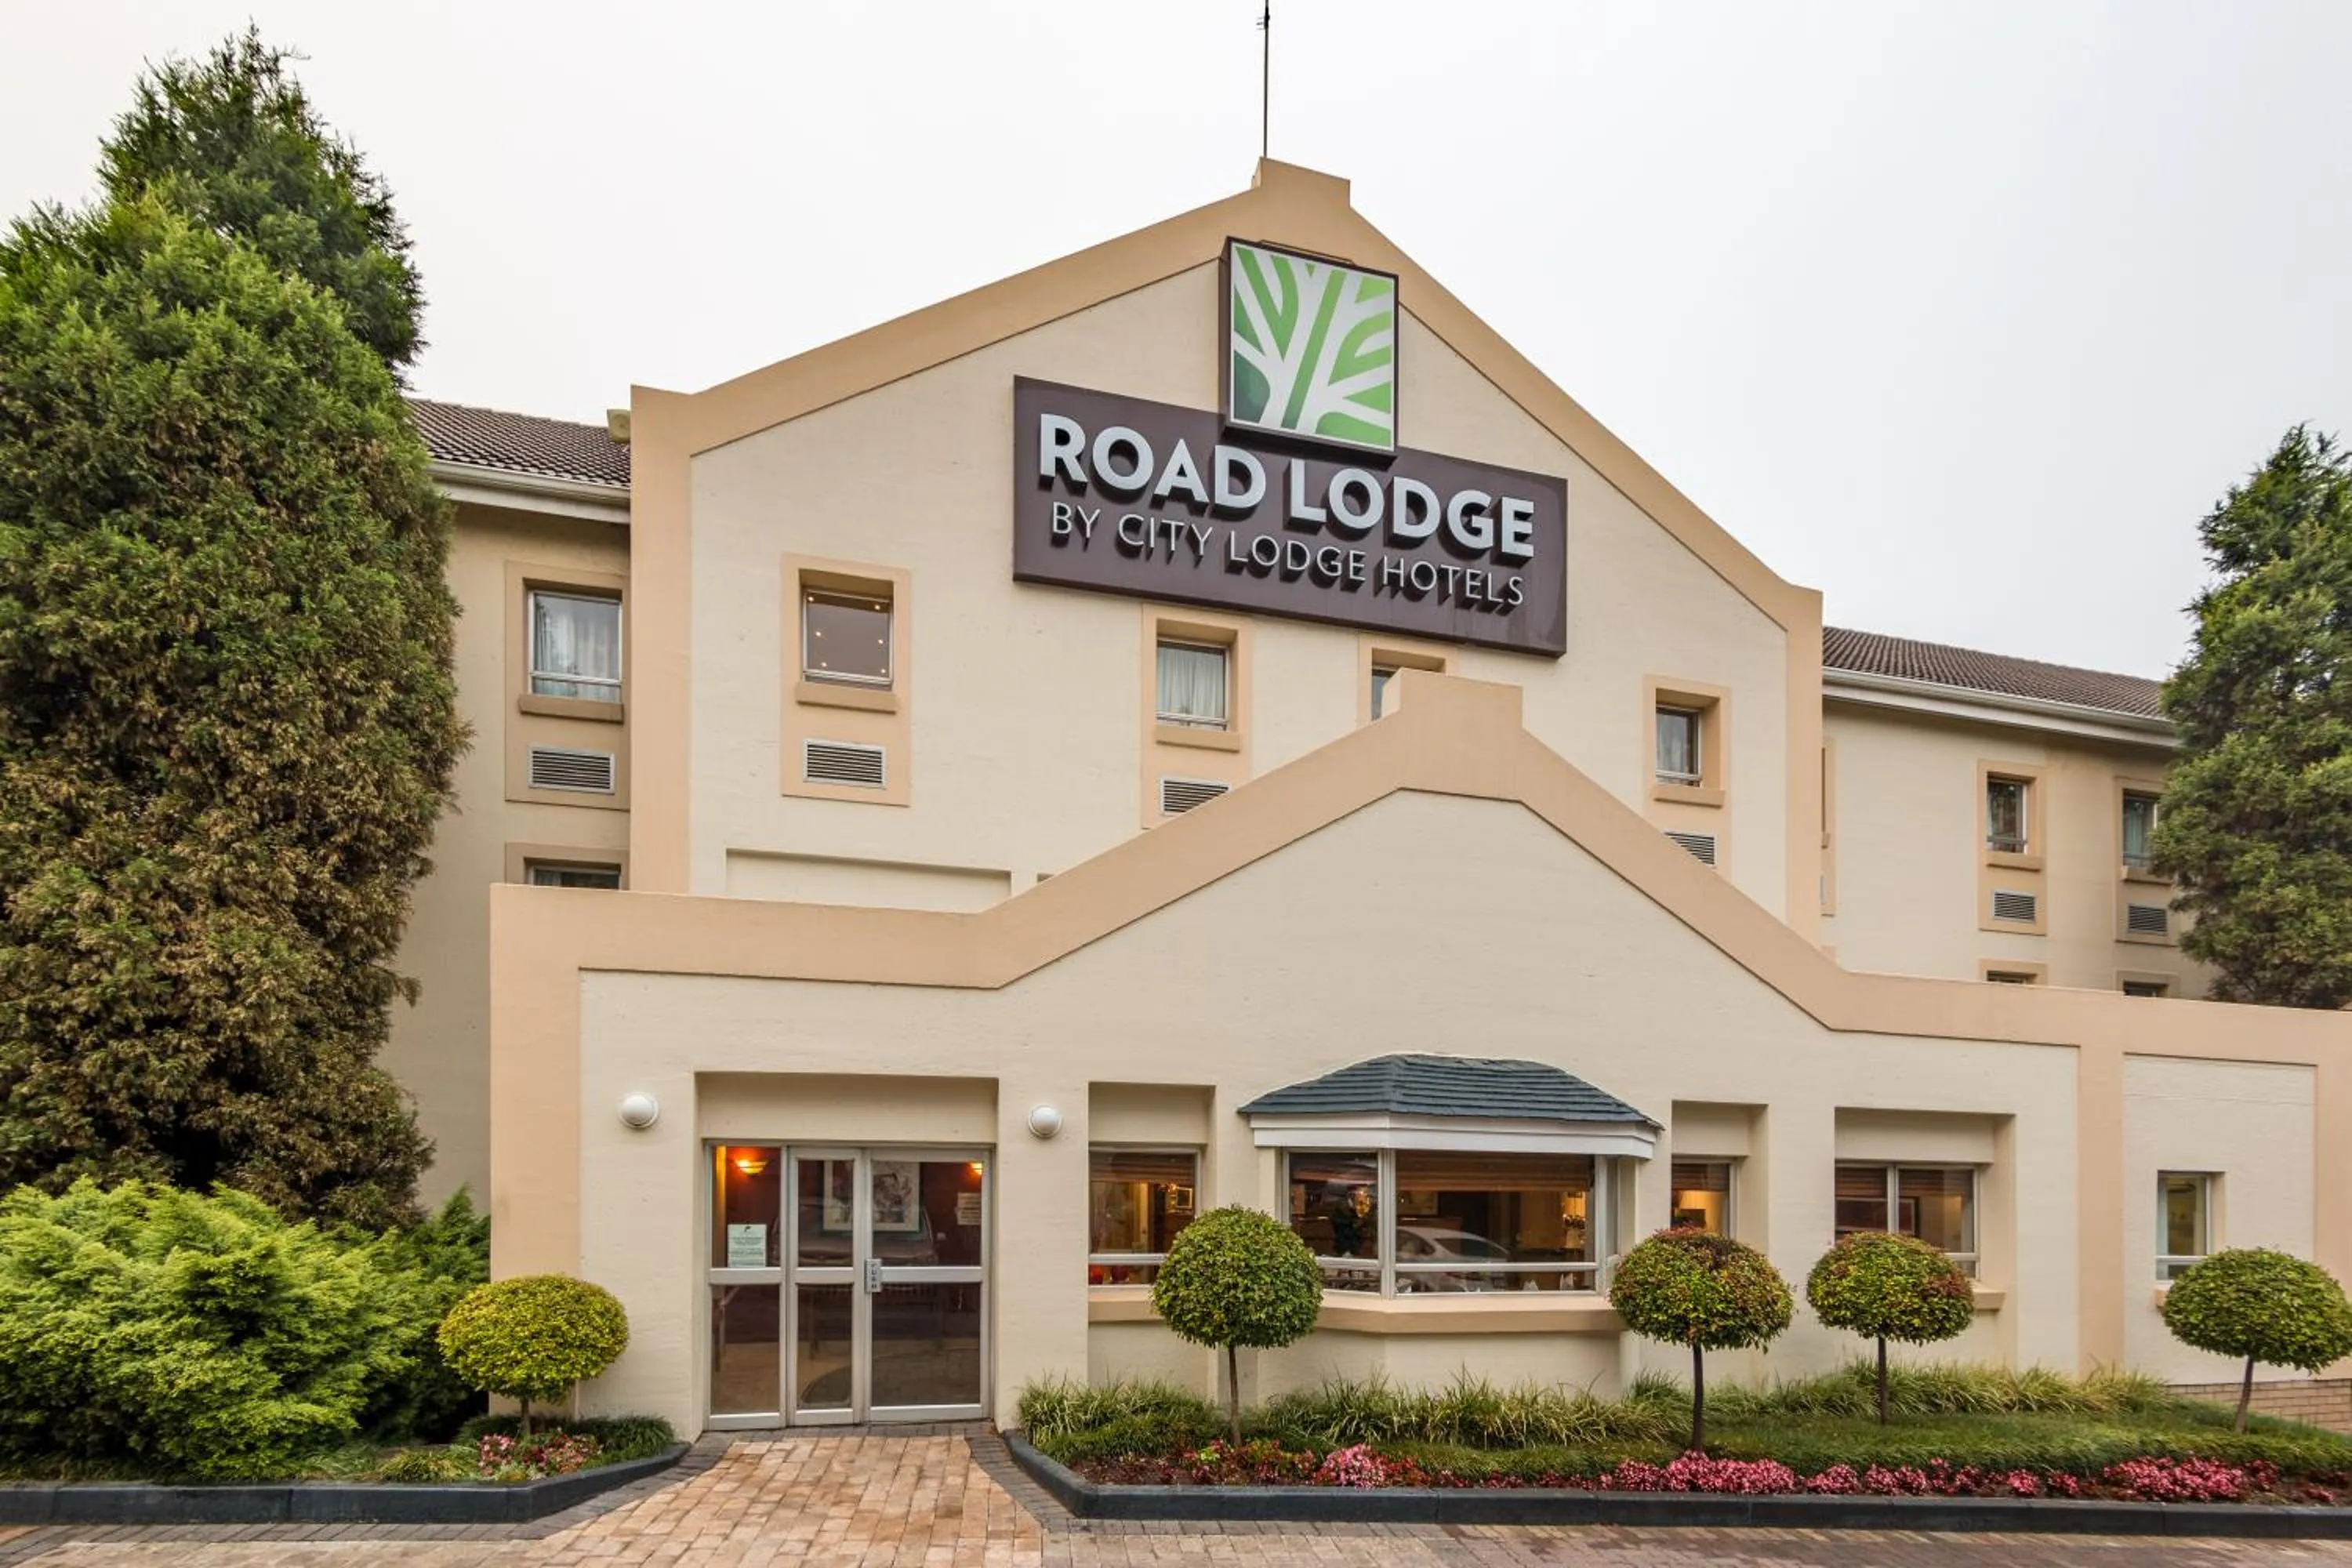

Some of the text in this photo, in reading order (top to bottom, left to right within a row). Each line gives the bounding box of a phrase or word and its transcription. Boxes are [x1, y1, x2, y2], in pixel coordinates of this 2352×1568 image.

[1040, 413, 1534, 558] ROAD LODGE
[1052, 501, 1524, 605] BY CITY LODGE HOTELS
